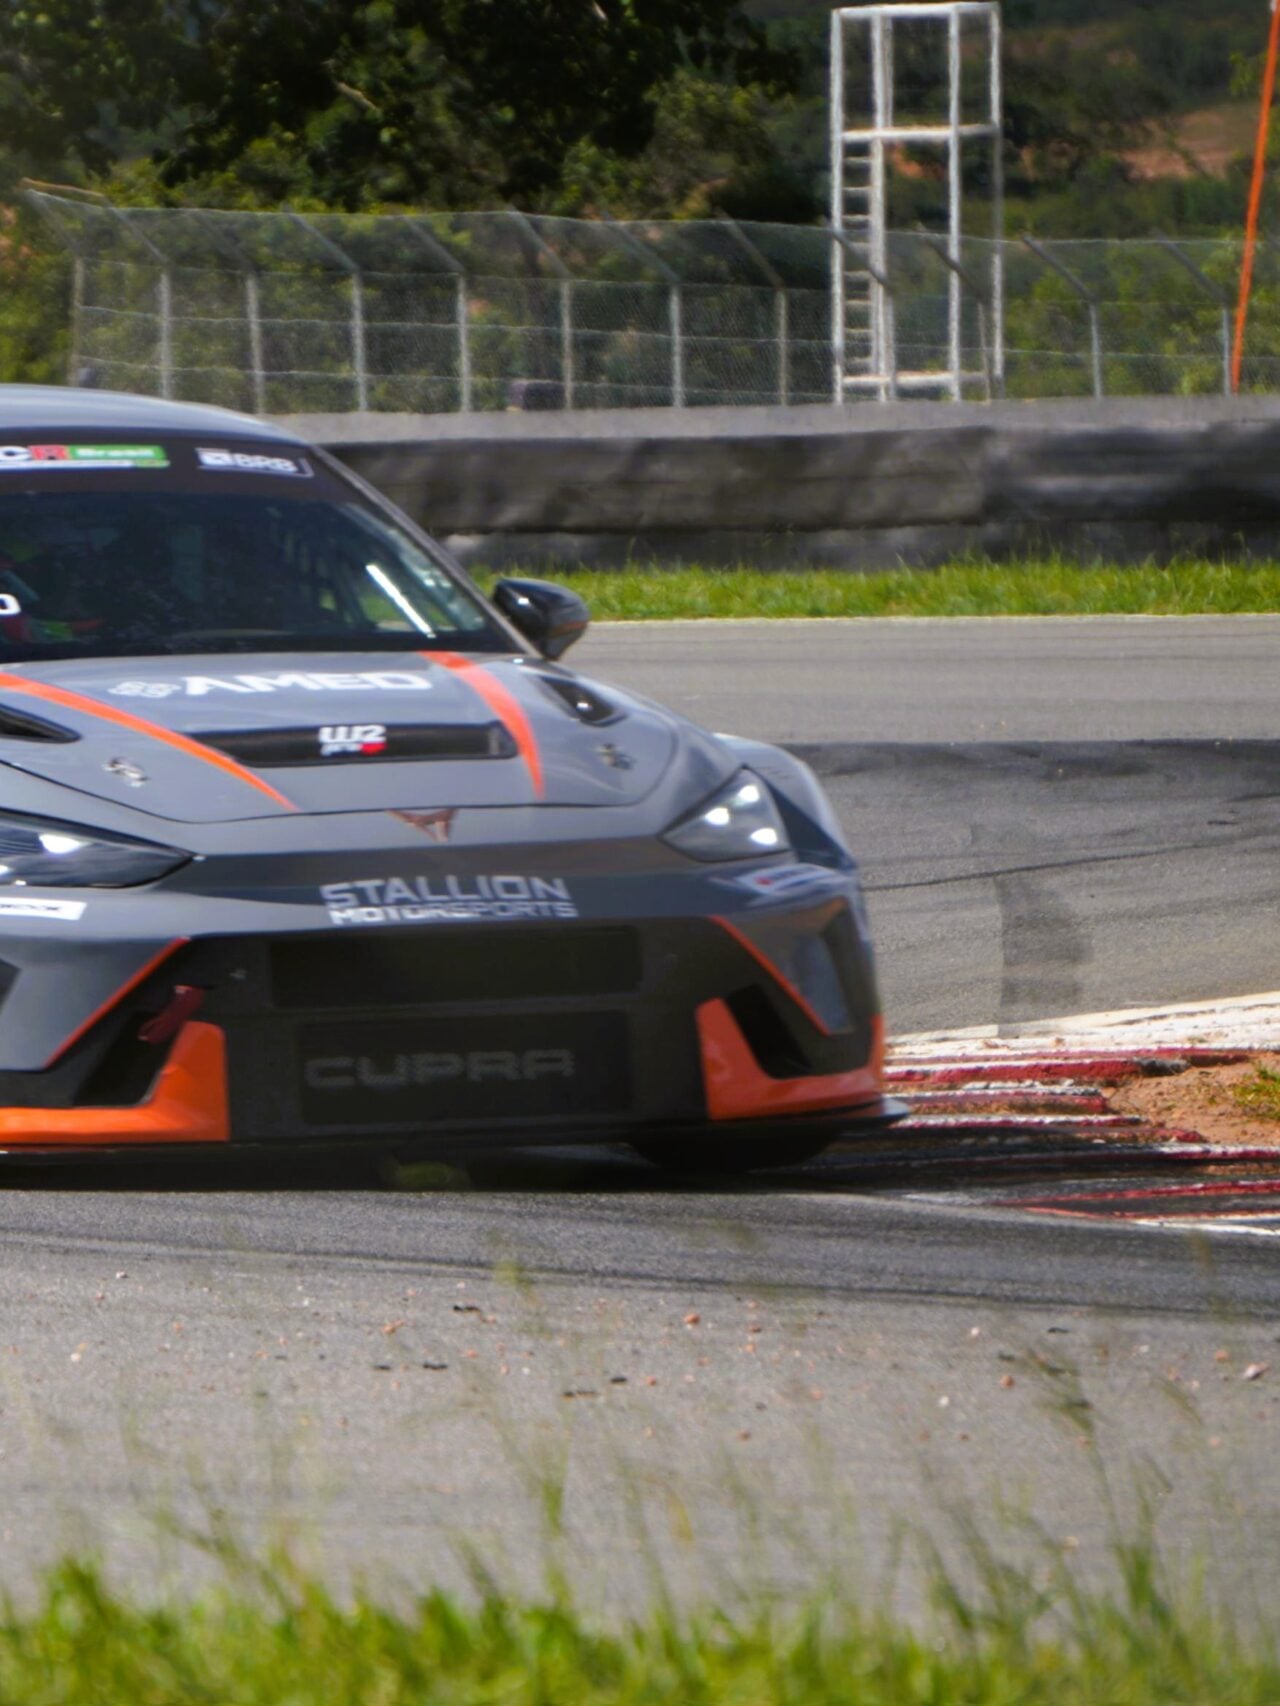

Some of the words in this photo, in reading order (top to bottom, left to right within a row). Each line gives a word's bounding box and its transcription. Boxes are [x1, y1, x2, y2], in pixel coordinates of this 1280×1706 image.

[183, 671, 432, 694] AMED
[321, 875, 572, 907] STALLION
[328, 901, 580, 925] MOTORSPORTS
[304, 1047, 578, 1090] CUPRA
